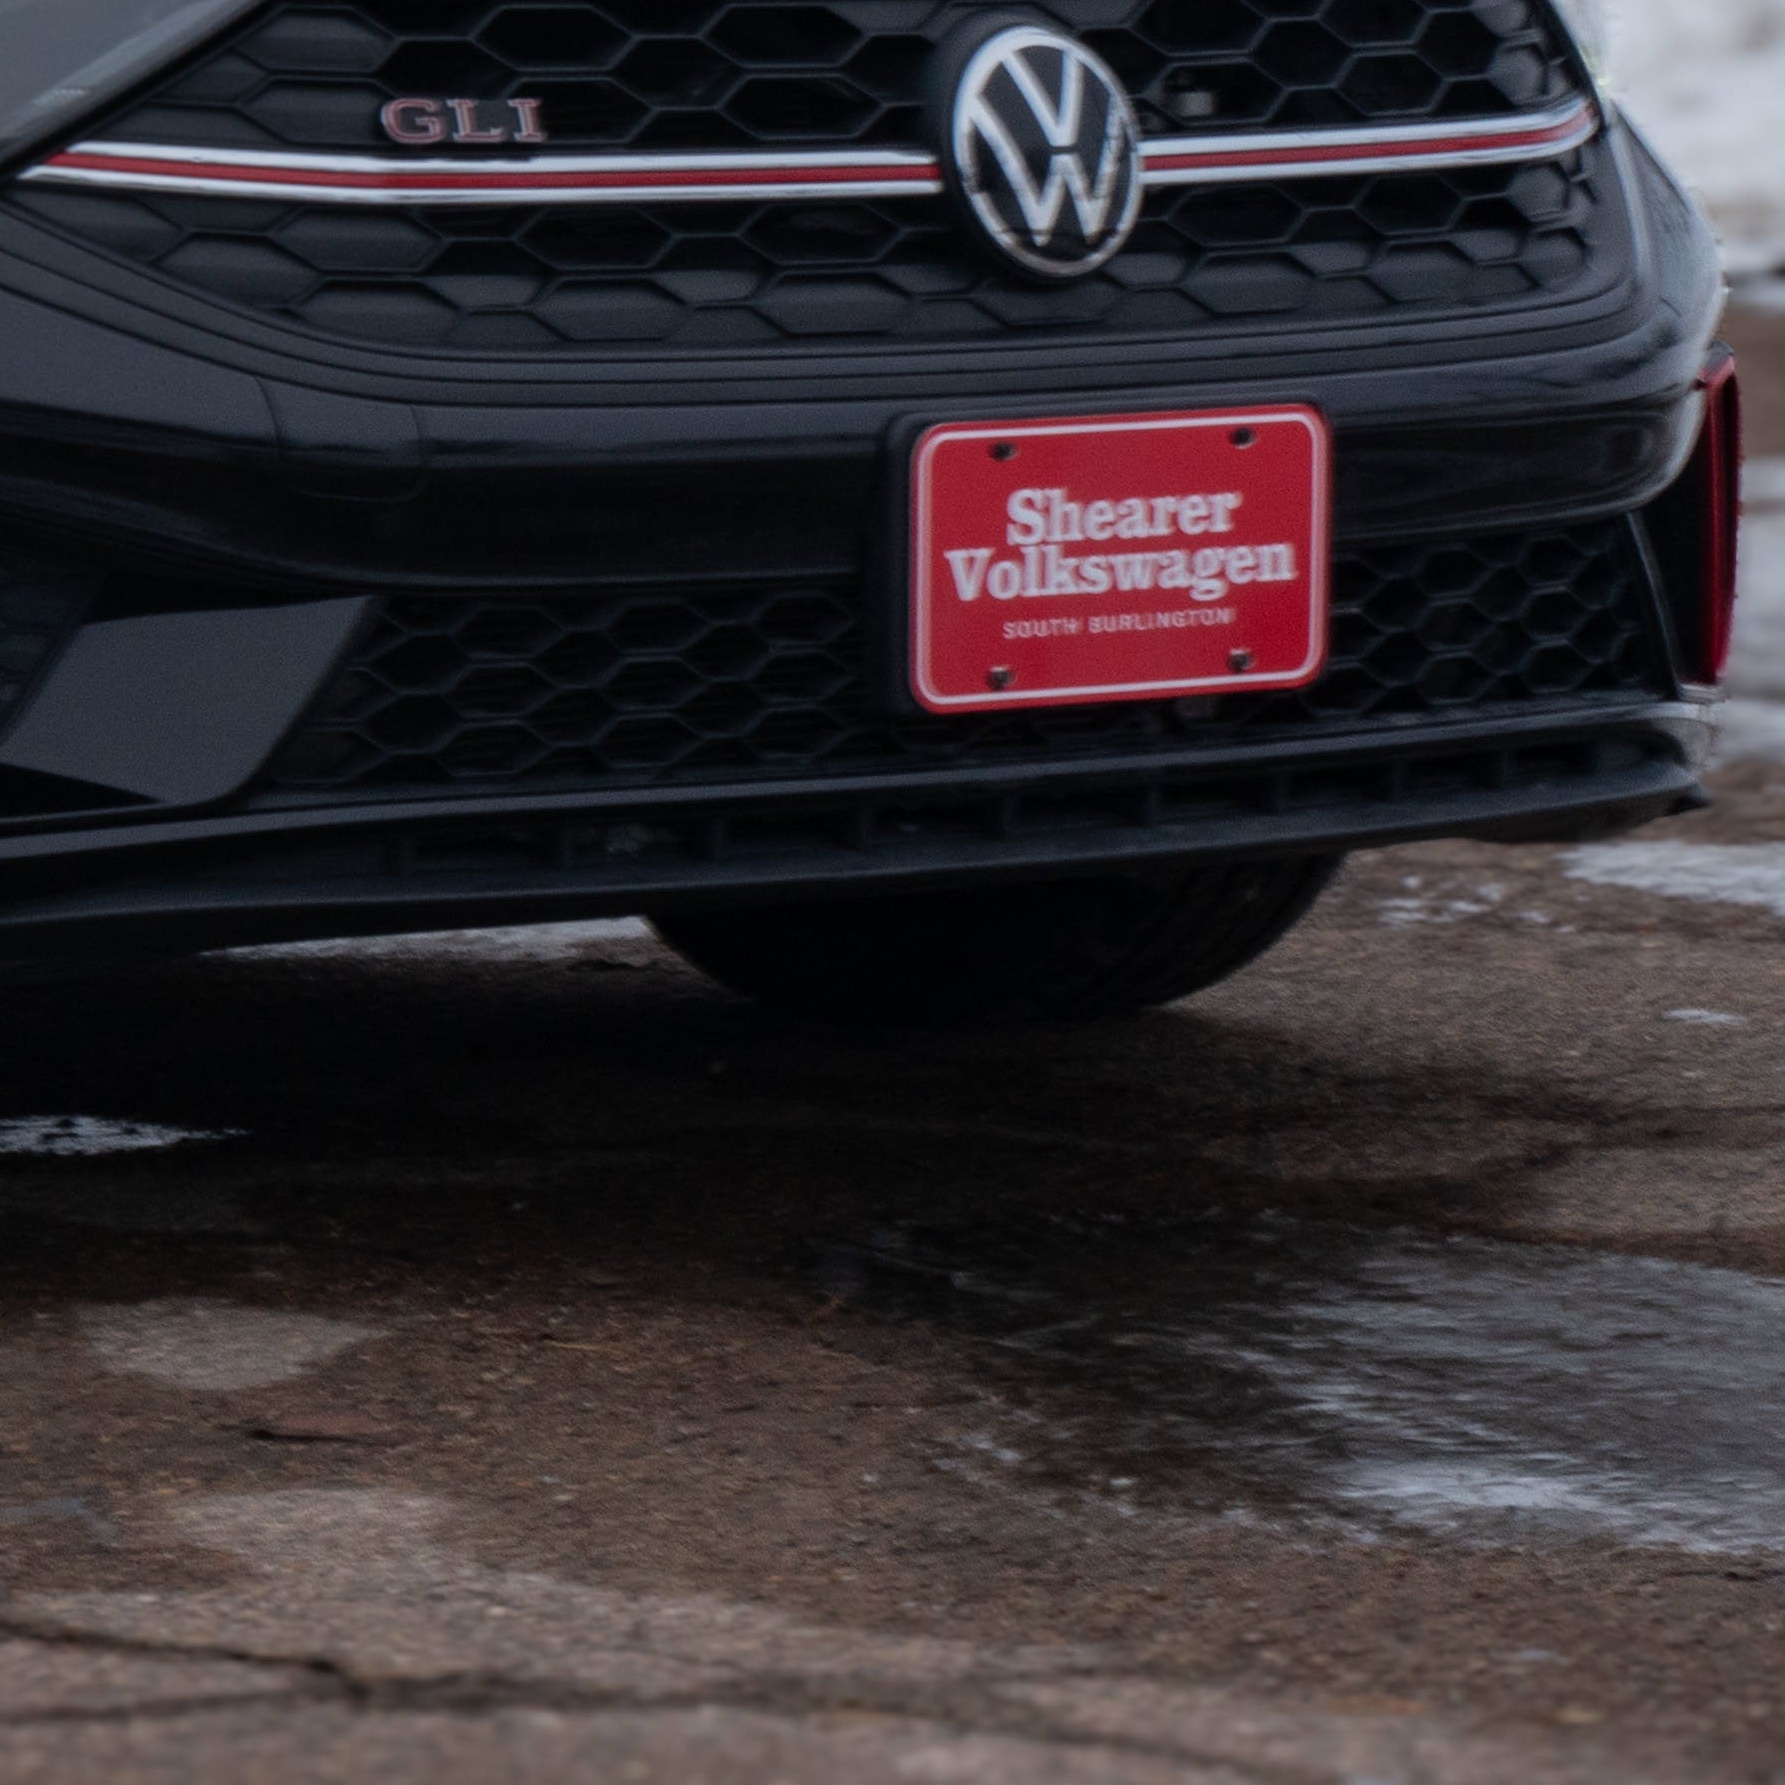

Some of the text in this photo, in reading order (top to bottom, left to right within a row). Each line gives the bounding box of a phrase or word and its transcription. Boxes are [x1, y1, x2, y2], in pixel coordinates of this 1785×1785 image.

[381, 98, 548, 144] GLI
[1007, 488, 1241, 545] Shearer
[944, 543, 1297, 601] Volkswagen
[1003, 608, 1236, 640] SOUTH BURLINGTON
